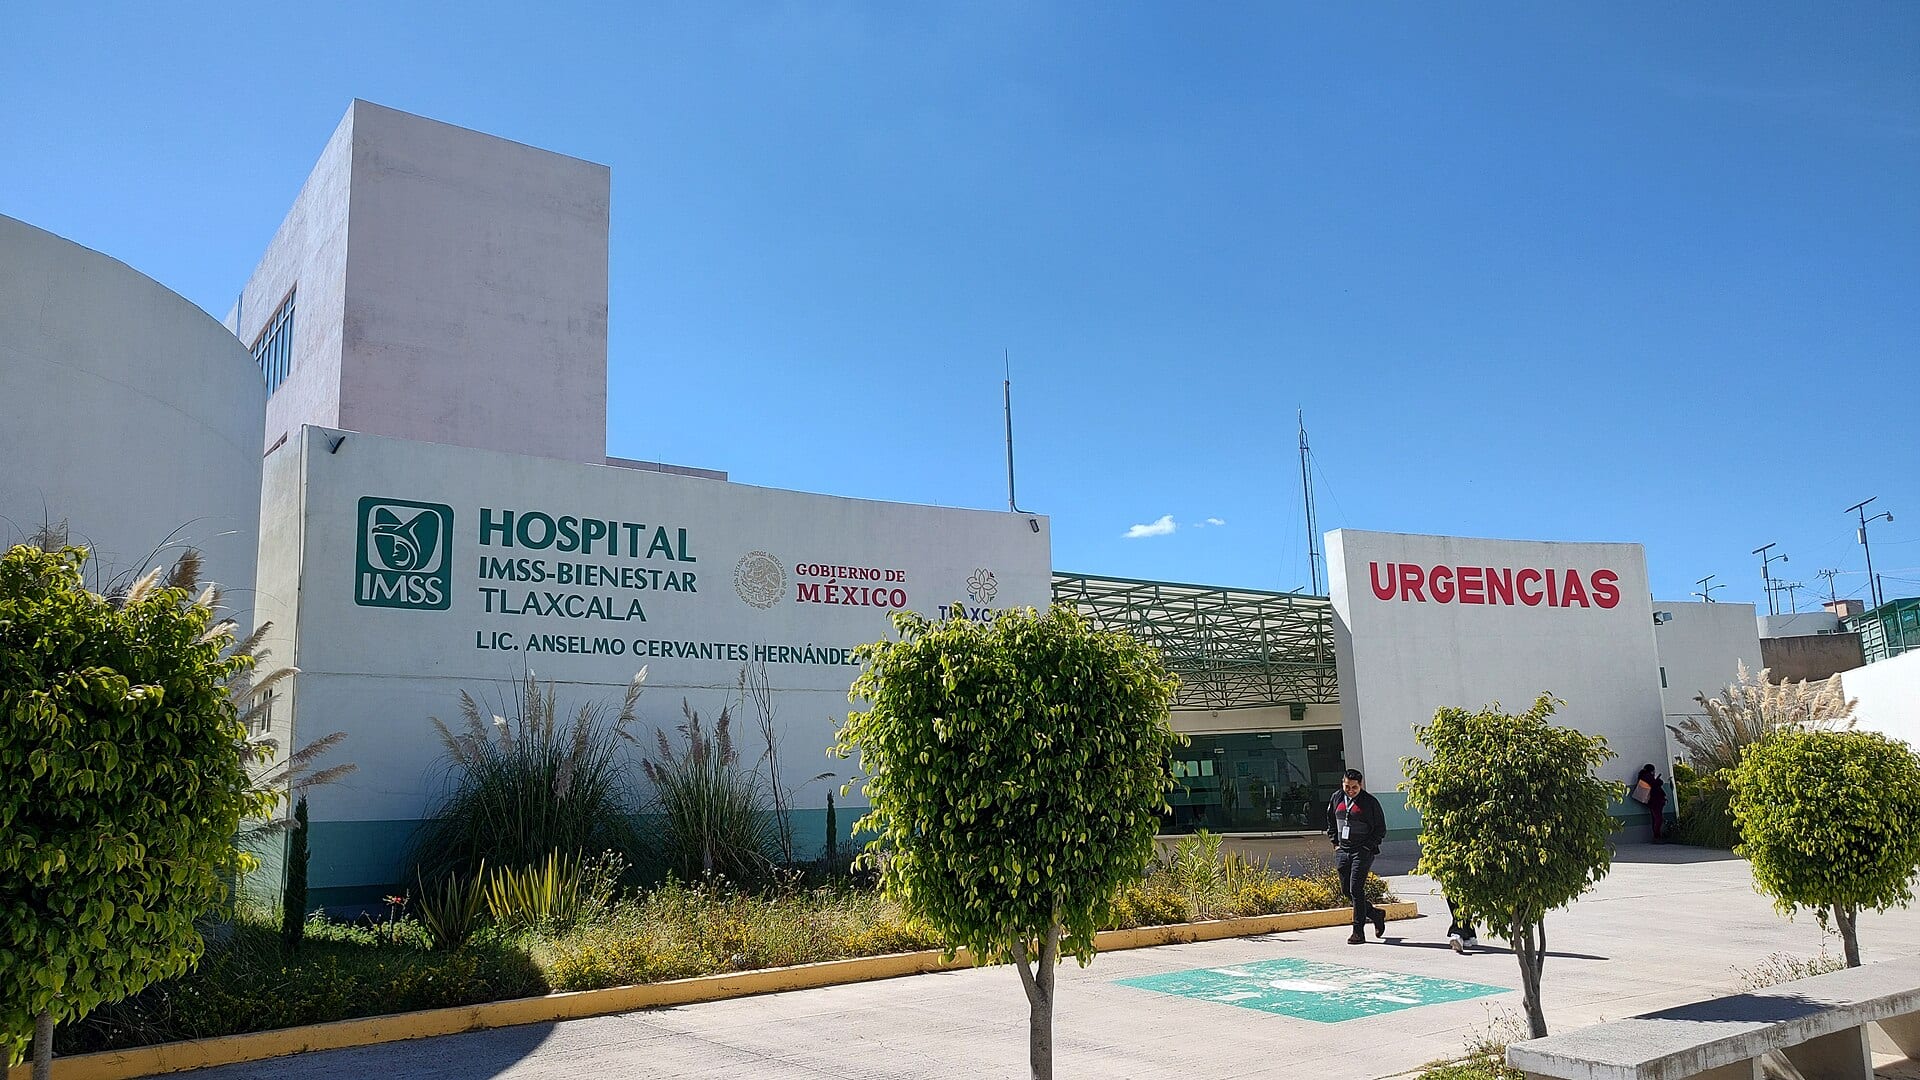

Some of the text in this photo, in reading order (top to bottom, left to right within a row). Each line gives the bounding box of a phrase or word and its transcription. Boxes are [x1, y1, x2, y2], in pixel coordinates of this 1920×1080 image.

[479, 507, 697, 563] HOSPITAL
[362, 572, 443, 605] IMSS
[479, 556, 697, 592] IMSS-BIENESTAR
[796, 563, 906, 583] GOBIERNO DE
[1369, 561, 1620, 609] URGENCIAS
[479, 587, 647, 622] TLAXCALA
[796, 580, 907, 608] MÉXICO
[476, 631, 860, 666] LIC. ANSELMO CERVANTES HERNÁNDEZ
